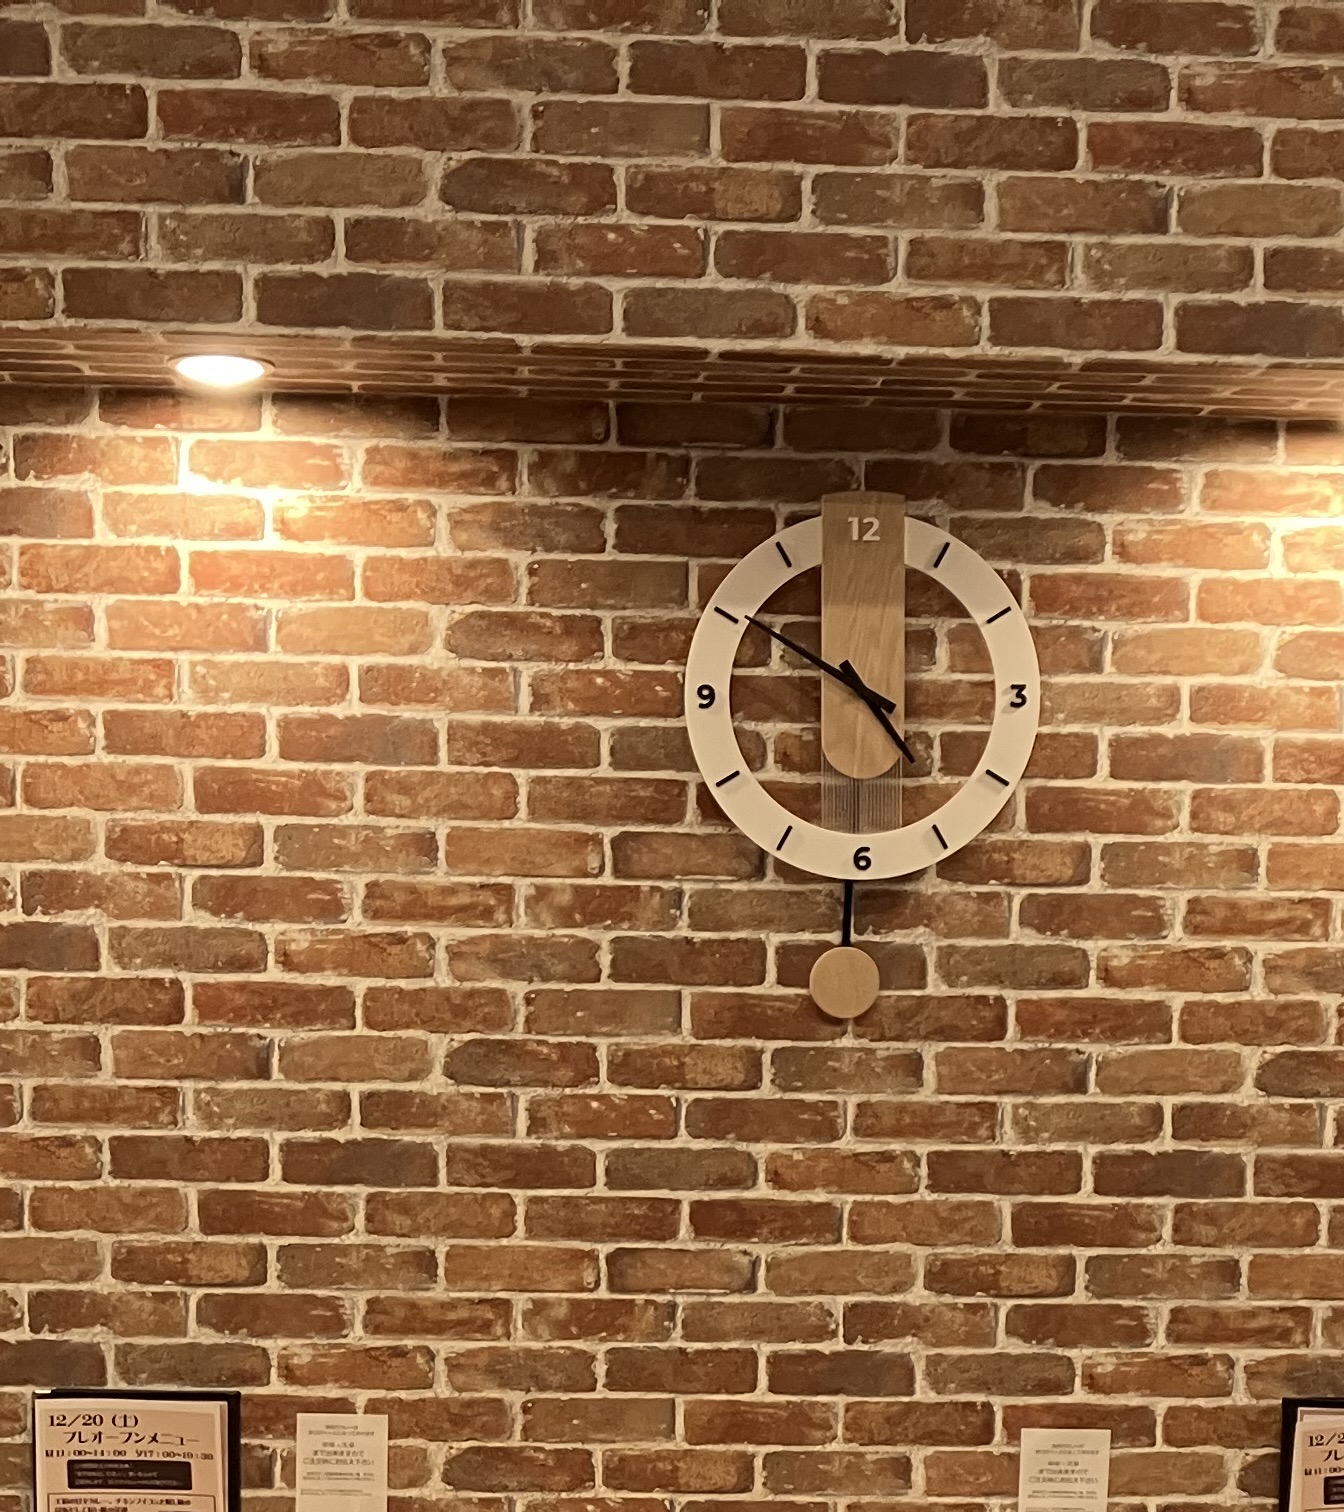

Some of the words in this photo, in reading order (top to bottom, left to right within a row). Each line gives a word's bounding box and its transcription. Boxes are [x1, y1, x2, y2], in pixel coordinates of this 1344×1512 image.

[847, 516, 881, 542] 12
[696, 683, 716, 710] 9
[1009, 683, 1028, 709] 3
[852, 846, 872, 872] 6
